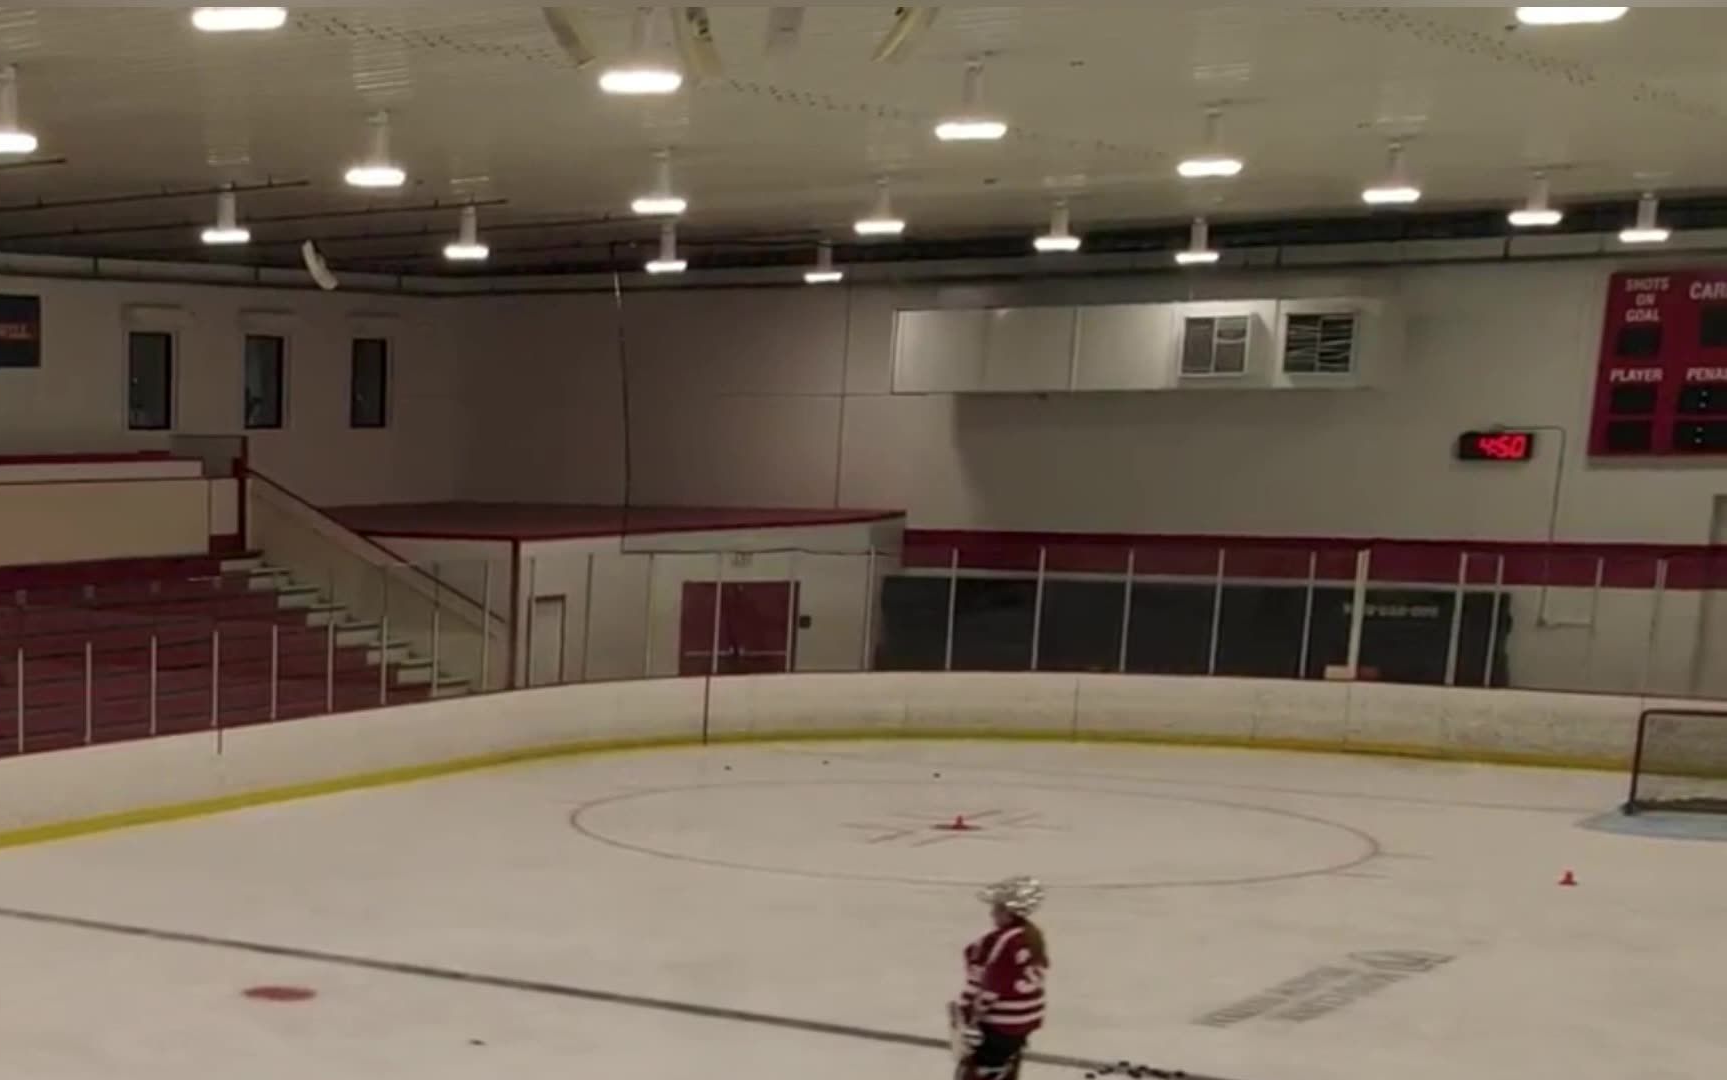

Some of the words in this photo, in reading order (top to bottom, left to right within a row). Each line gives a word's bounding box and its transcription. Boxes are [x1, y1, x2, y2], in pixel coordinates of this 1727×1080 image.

[1624, 276, 1670, 292] SHOTS
[1635, 292, 1655, 307] ON
[1625, 307, 1660, 322] GOAL
[1609, 368, 1664, 383] PLAYER
